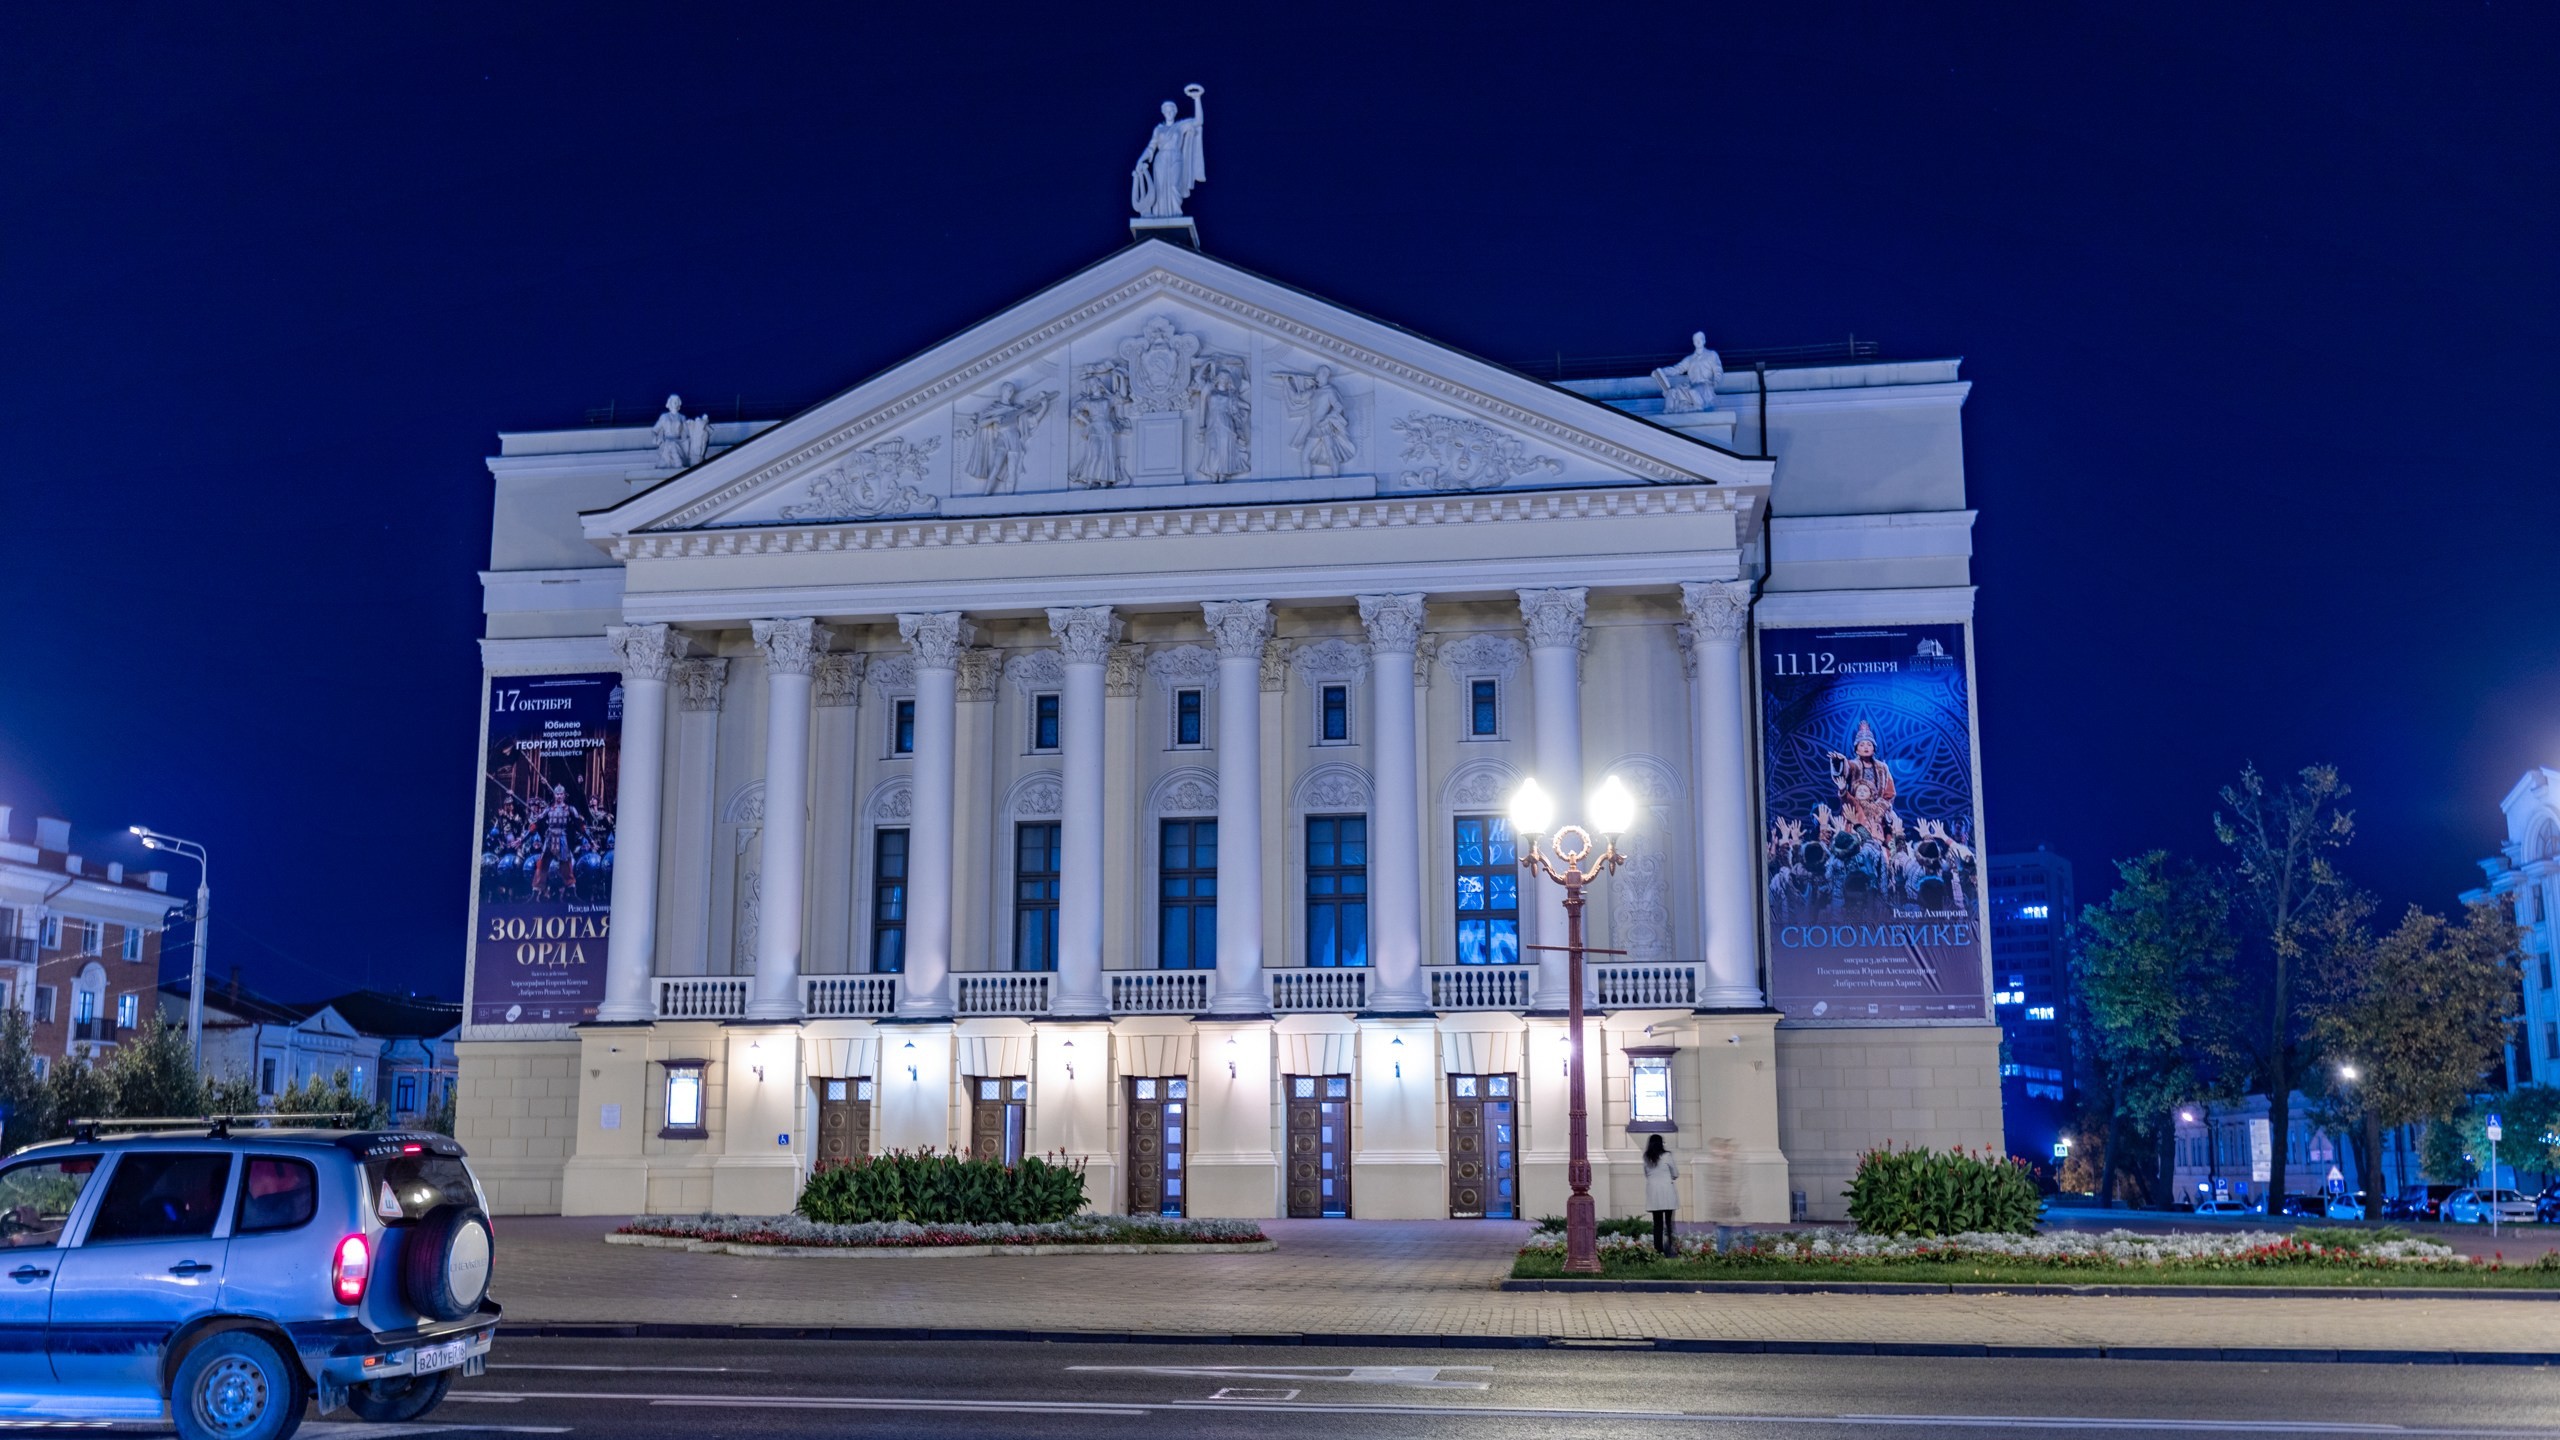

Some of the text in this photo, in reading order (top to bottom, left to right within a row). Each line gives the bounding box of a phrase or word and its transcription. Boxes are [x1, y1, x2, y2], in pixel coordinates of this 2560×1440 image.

[1838, 661, 1898, 674] ОКТЯБРЯ
[495, 689, 572, 712] 17 ОКТЯБРЯ
[545, 721, 580, 729] Юбилею
[543, 730, 582, 738] хореографа
[516, 738, 606, 750] ГЕОРГИЯ КОВТУНА
[540, 750, 583, 758] посвящается
[488, 916, 610, 941] ЗОЛОТАЯ
[1781, 924, 1971, 948] СЮЮМБИКЕ
[516, 942, 587, 969] ОРДА
[369, 1145, 399, 1156] NIVA
